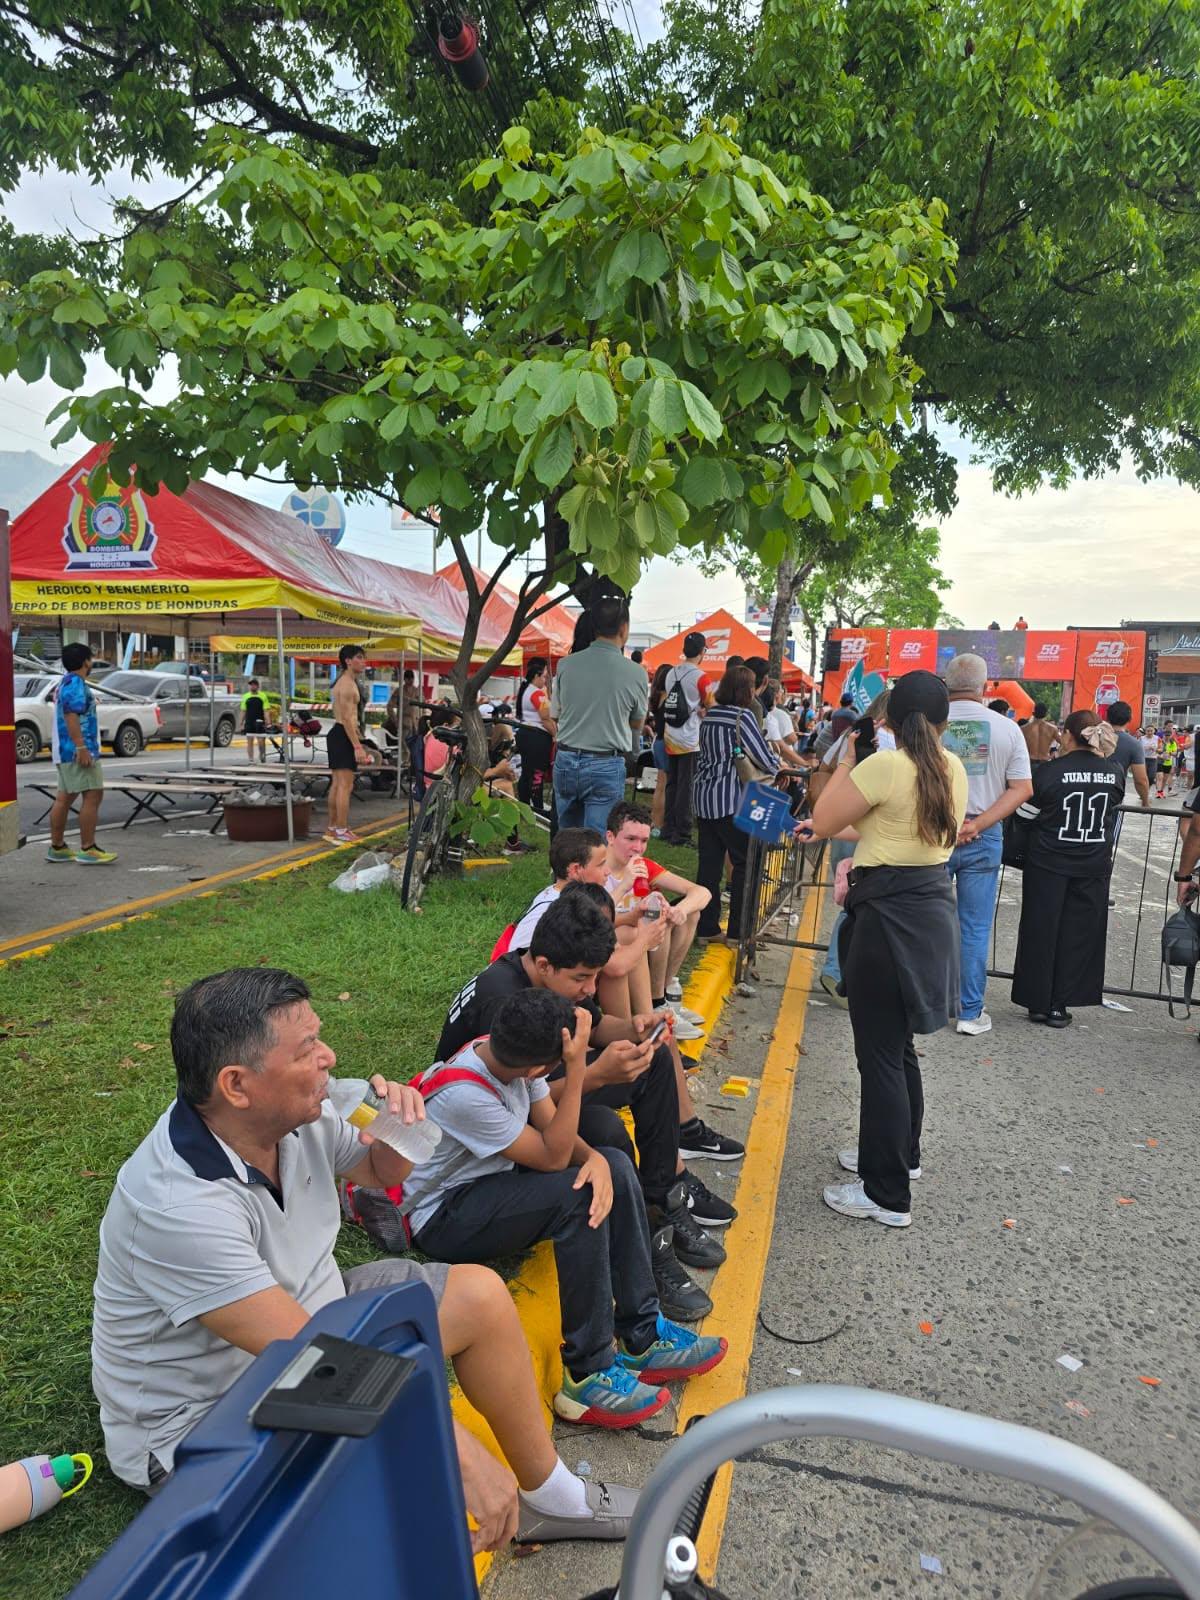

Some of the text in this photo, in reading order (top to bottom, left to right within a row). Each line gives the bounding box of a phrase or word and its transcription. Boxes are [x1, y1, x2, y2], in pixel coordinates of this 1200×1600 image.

[37, 584, 190, 595] HEROICO Y BENEMERITO
[12, 599, 238, 611] ERPO DE BOMBEROS DE HONDURAS
[1090, 640, 1125, 658] 50
[1062, 771, 1116, 785] JUAN 15:13
[1058, 791, 1108, 842] 11
